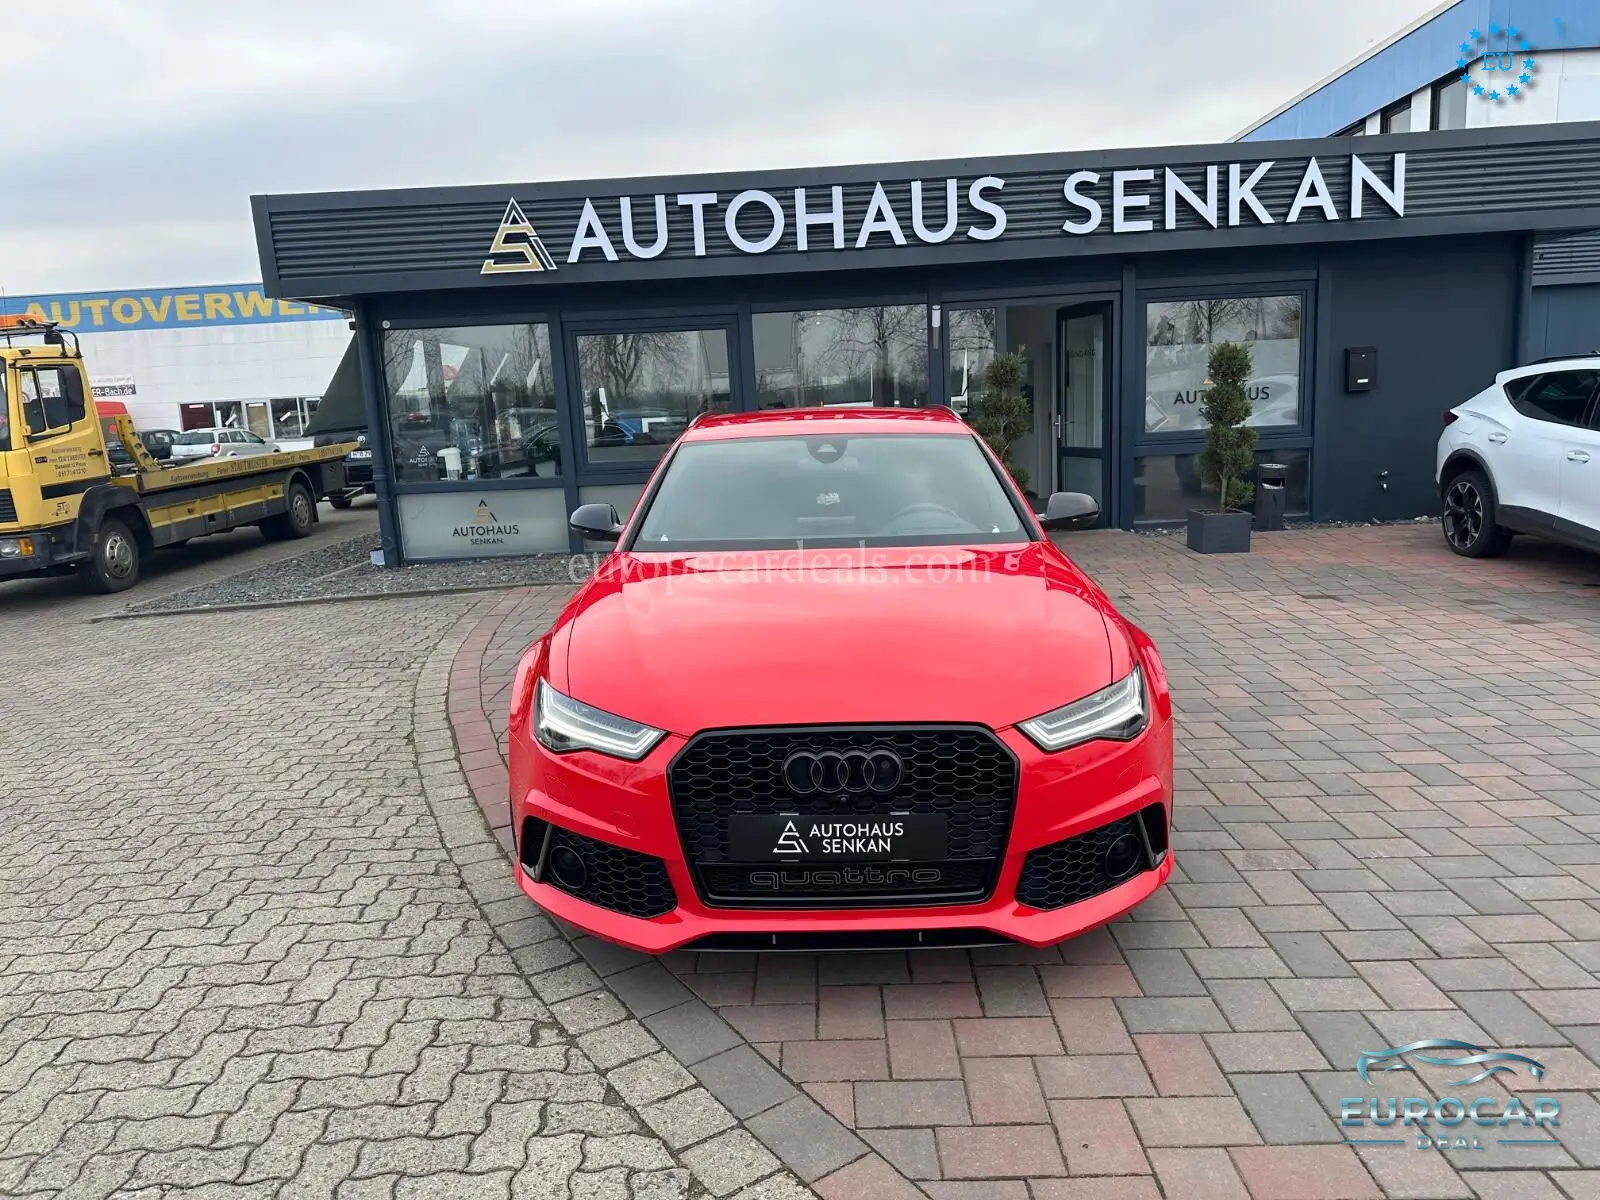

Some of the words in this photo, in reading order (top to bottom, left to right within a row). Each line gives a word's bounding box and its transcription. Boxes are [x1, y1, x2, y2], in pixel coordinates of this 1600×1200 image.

[567, 176, 1007, 263] AUTOHAUS
[1062, 153, 1406, 235] SENKAN
[452, 525, 519, 537] AUTOHAUS
[470, 537, 504, 546] SENKAN
[809, 822, 904, 838] AUTOHAUS
[822, 838, 891, 854] SENKAN
[749, 867, 941, 890] quattro
